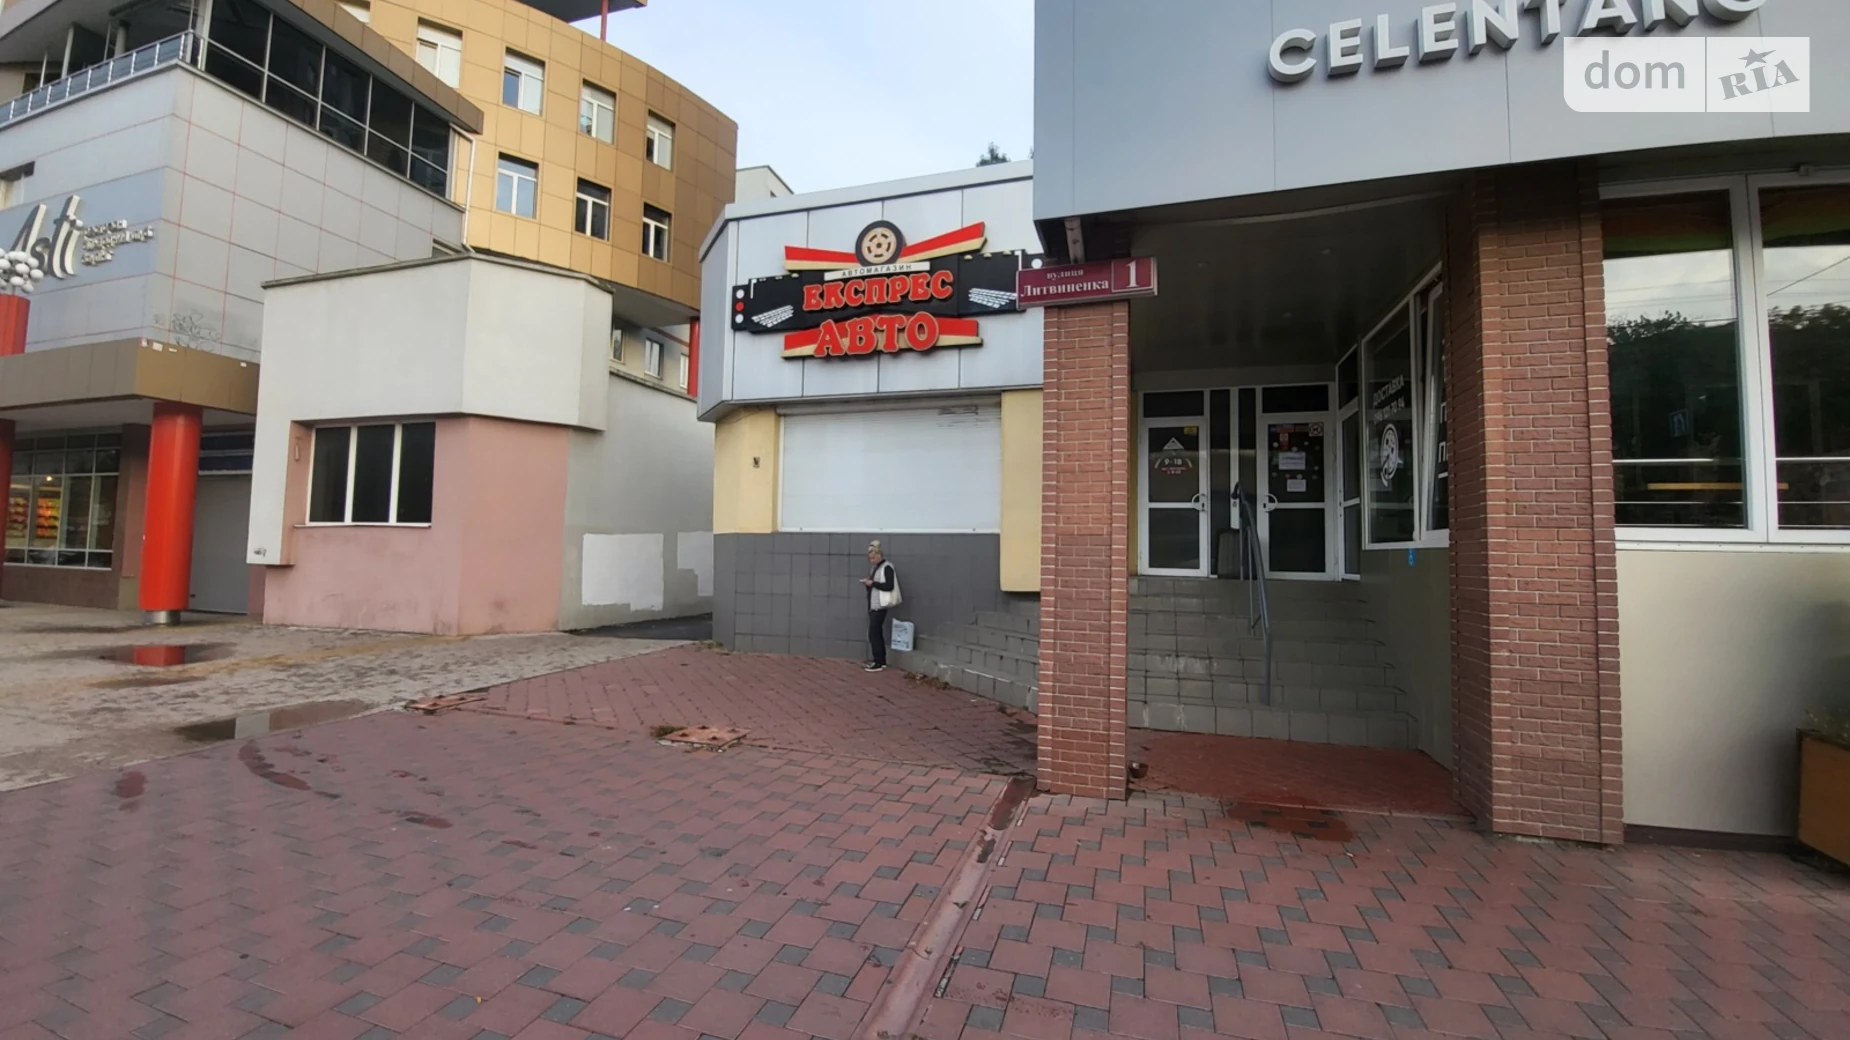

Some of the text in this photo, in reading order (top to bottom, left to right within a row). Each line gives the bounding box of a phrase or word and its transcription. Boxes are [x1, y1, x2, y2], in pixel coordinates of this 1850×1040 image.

[1269, 0, 1767, 84] CELENTA
[841, 264, 912, 277] АВТОМАГАЗИН
[1046, 269, 1084, 281] вулиця
[1125, 259, 1139, 288] 1
[803, 270, 953, 311] ЕКСПРЕС
[1020, 280, 1110, 298] Литвиненка
[813, 311, 940, 358] АВТО
